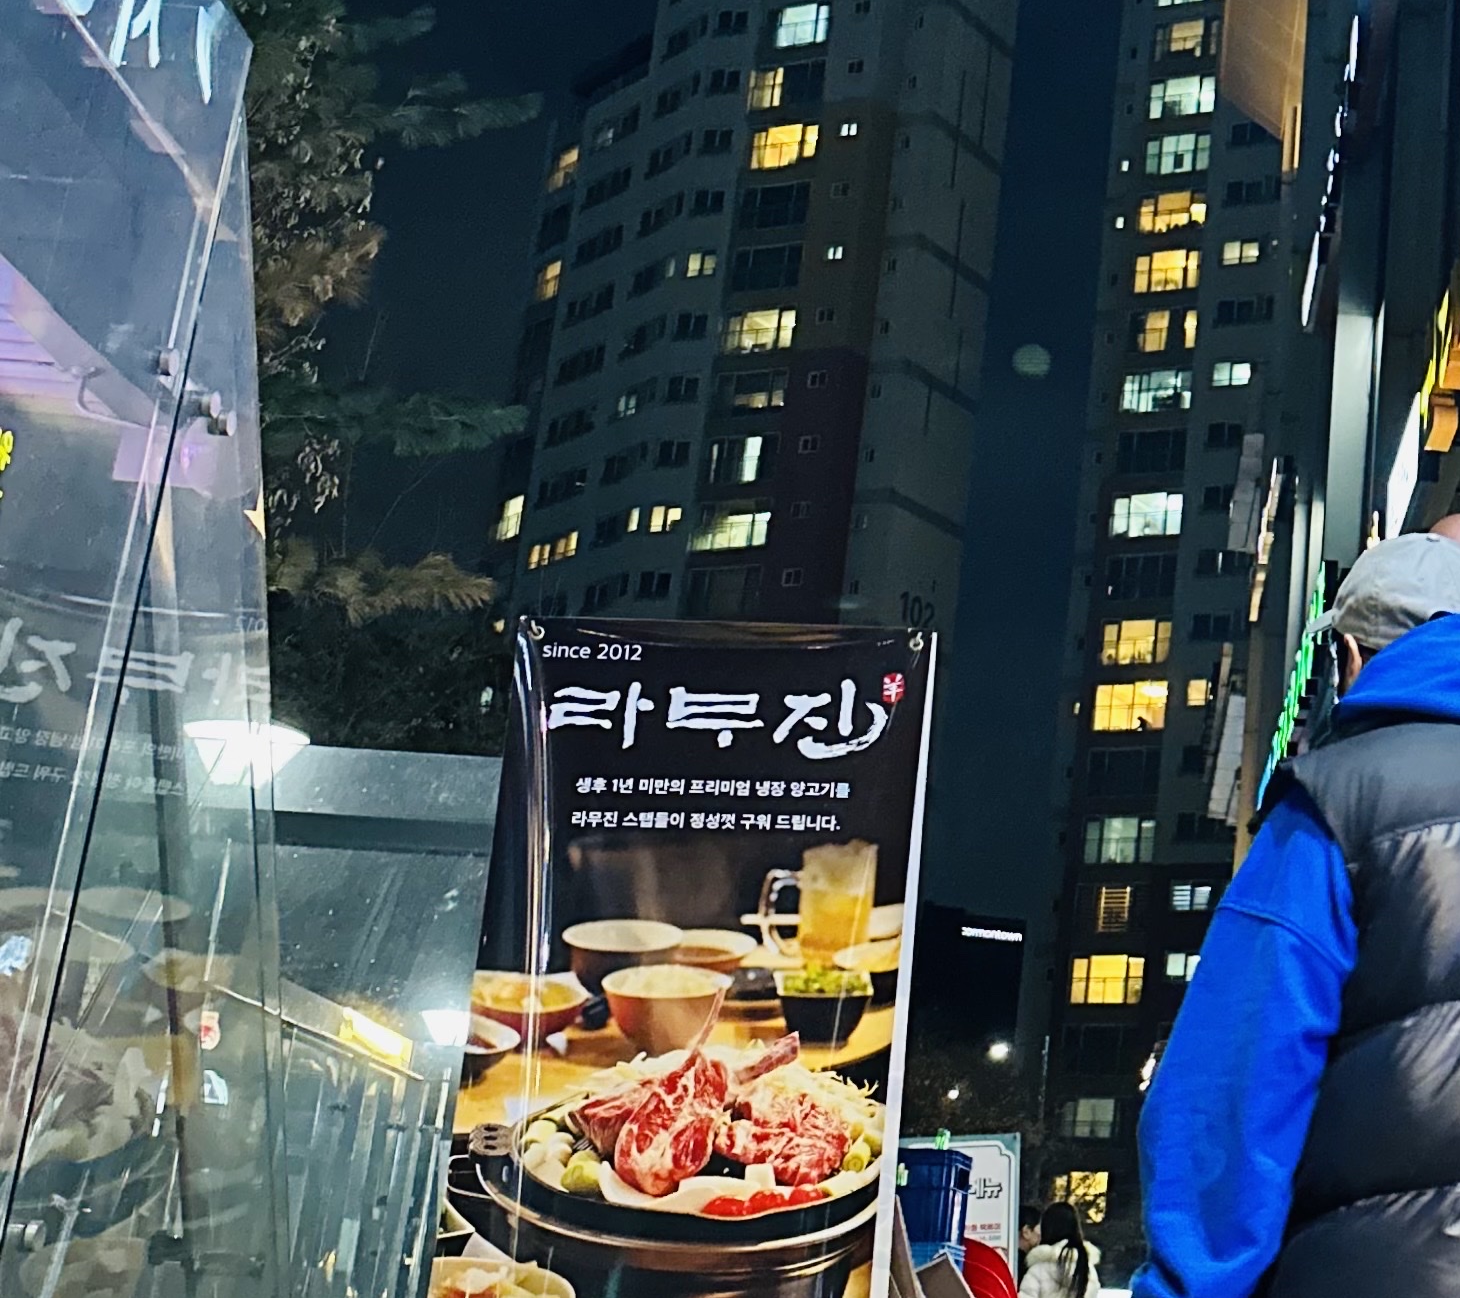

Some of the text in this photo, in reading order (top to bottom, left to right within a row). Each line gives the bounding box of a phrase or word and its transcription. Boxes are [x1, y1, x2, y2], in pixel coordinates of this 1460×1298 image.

[542, 642, 642, 661] since 2012
[547, 678, 890, 760] 라무진
[576, 778, 850, 798] 생후 1년 미만의 프리미엄 냉장 양고기를
[571, 811, 840, 831] 라무진 스탭들이 정성껏 구워 드립니다.
